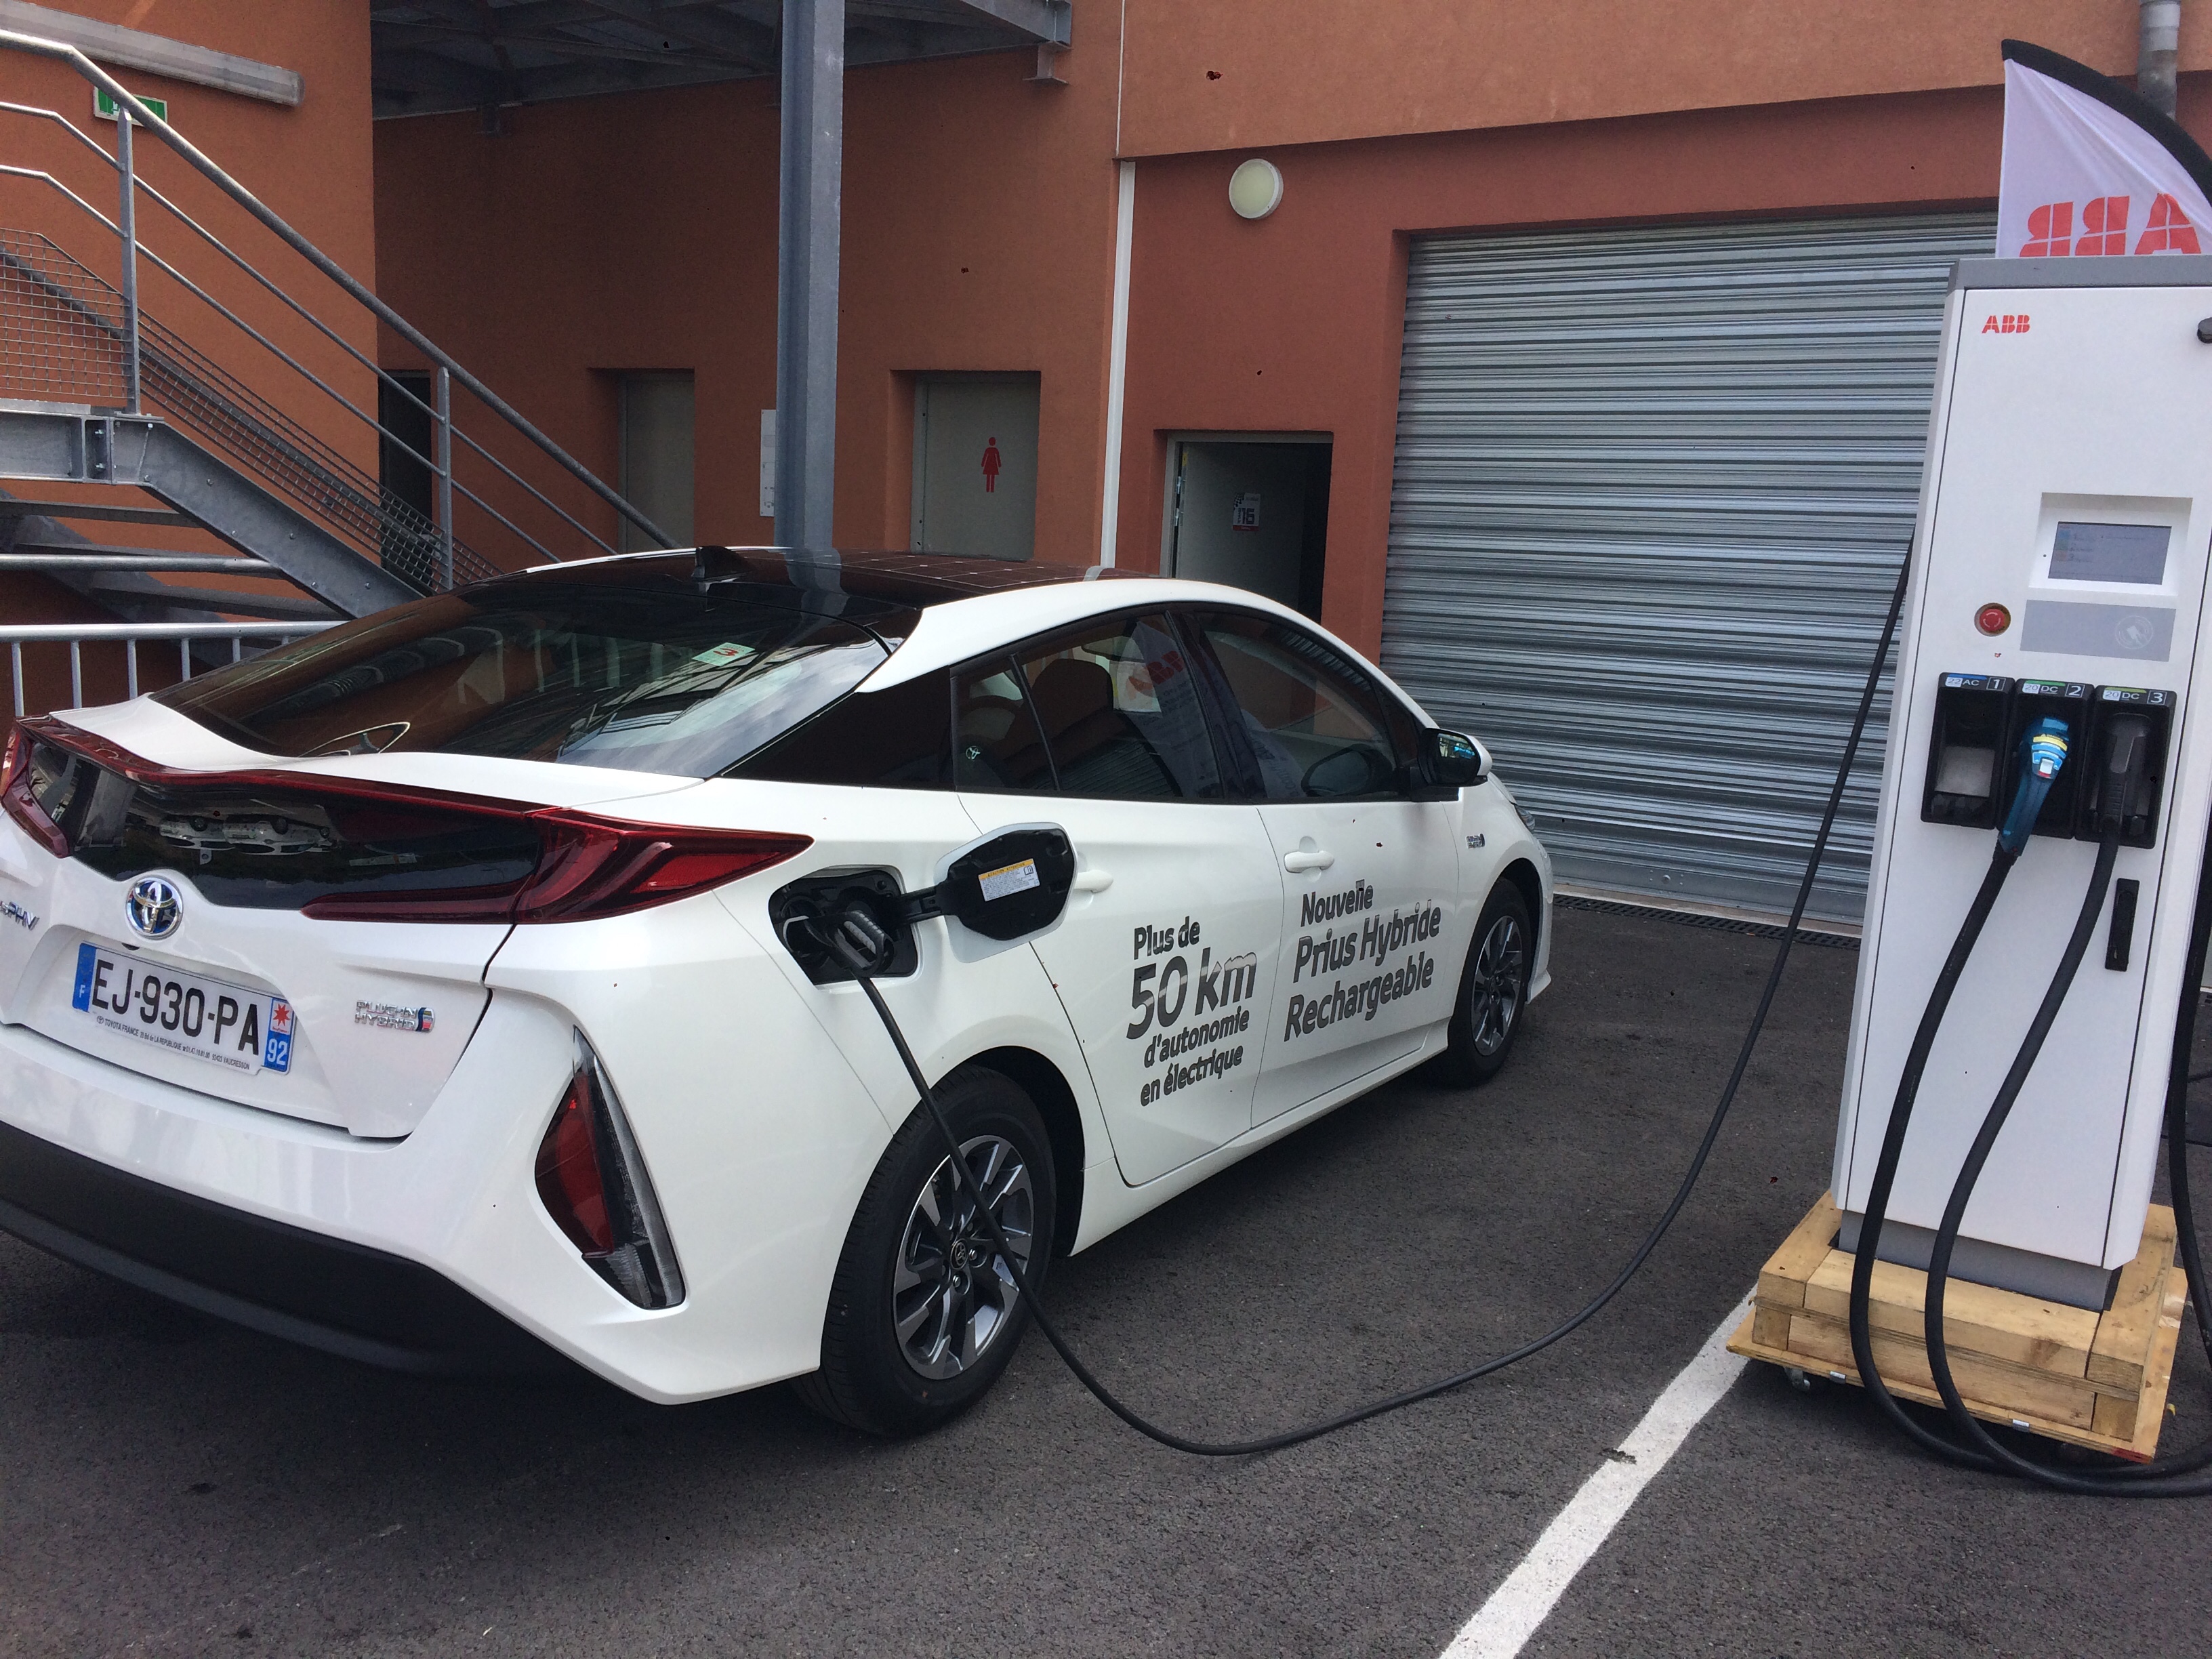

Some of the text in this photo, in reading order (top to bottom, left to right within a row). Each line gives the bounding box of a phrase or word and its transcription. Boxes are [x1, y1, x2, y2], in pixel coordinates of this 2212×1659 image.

[1982, 314, 2030, 333] ABB
[1993, 678, 2001, 689] 1
[2068, 685, 2082, 696] 2
[2150, 692, 2163, 703] 3
[1300, 879, 1374, 927] Nouvelle
[1134, 916, 1200, 960] Plus de
[1293, 899, 1441, 983] Prius Hybride
[79, 984, 86, 998] F
[91, 959, 260, 1056] EJ-930-PA
[1126, 947, 1257, 1040] 50 km
[1284, 951, 1434, 1042] Rechargeable
[104, 1018, 121, 1031] TOYOTA
[122, 1024, 139, 1037] FRANCE
[354, 1012, 416, 1031] HYBRID
[1144, 1005, 1250, 1068] d'autonomie
[267, 1038, 289, 1066] 92
[1140, 1045, 1244, 1107] en électrique
